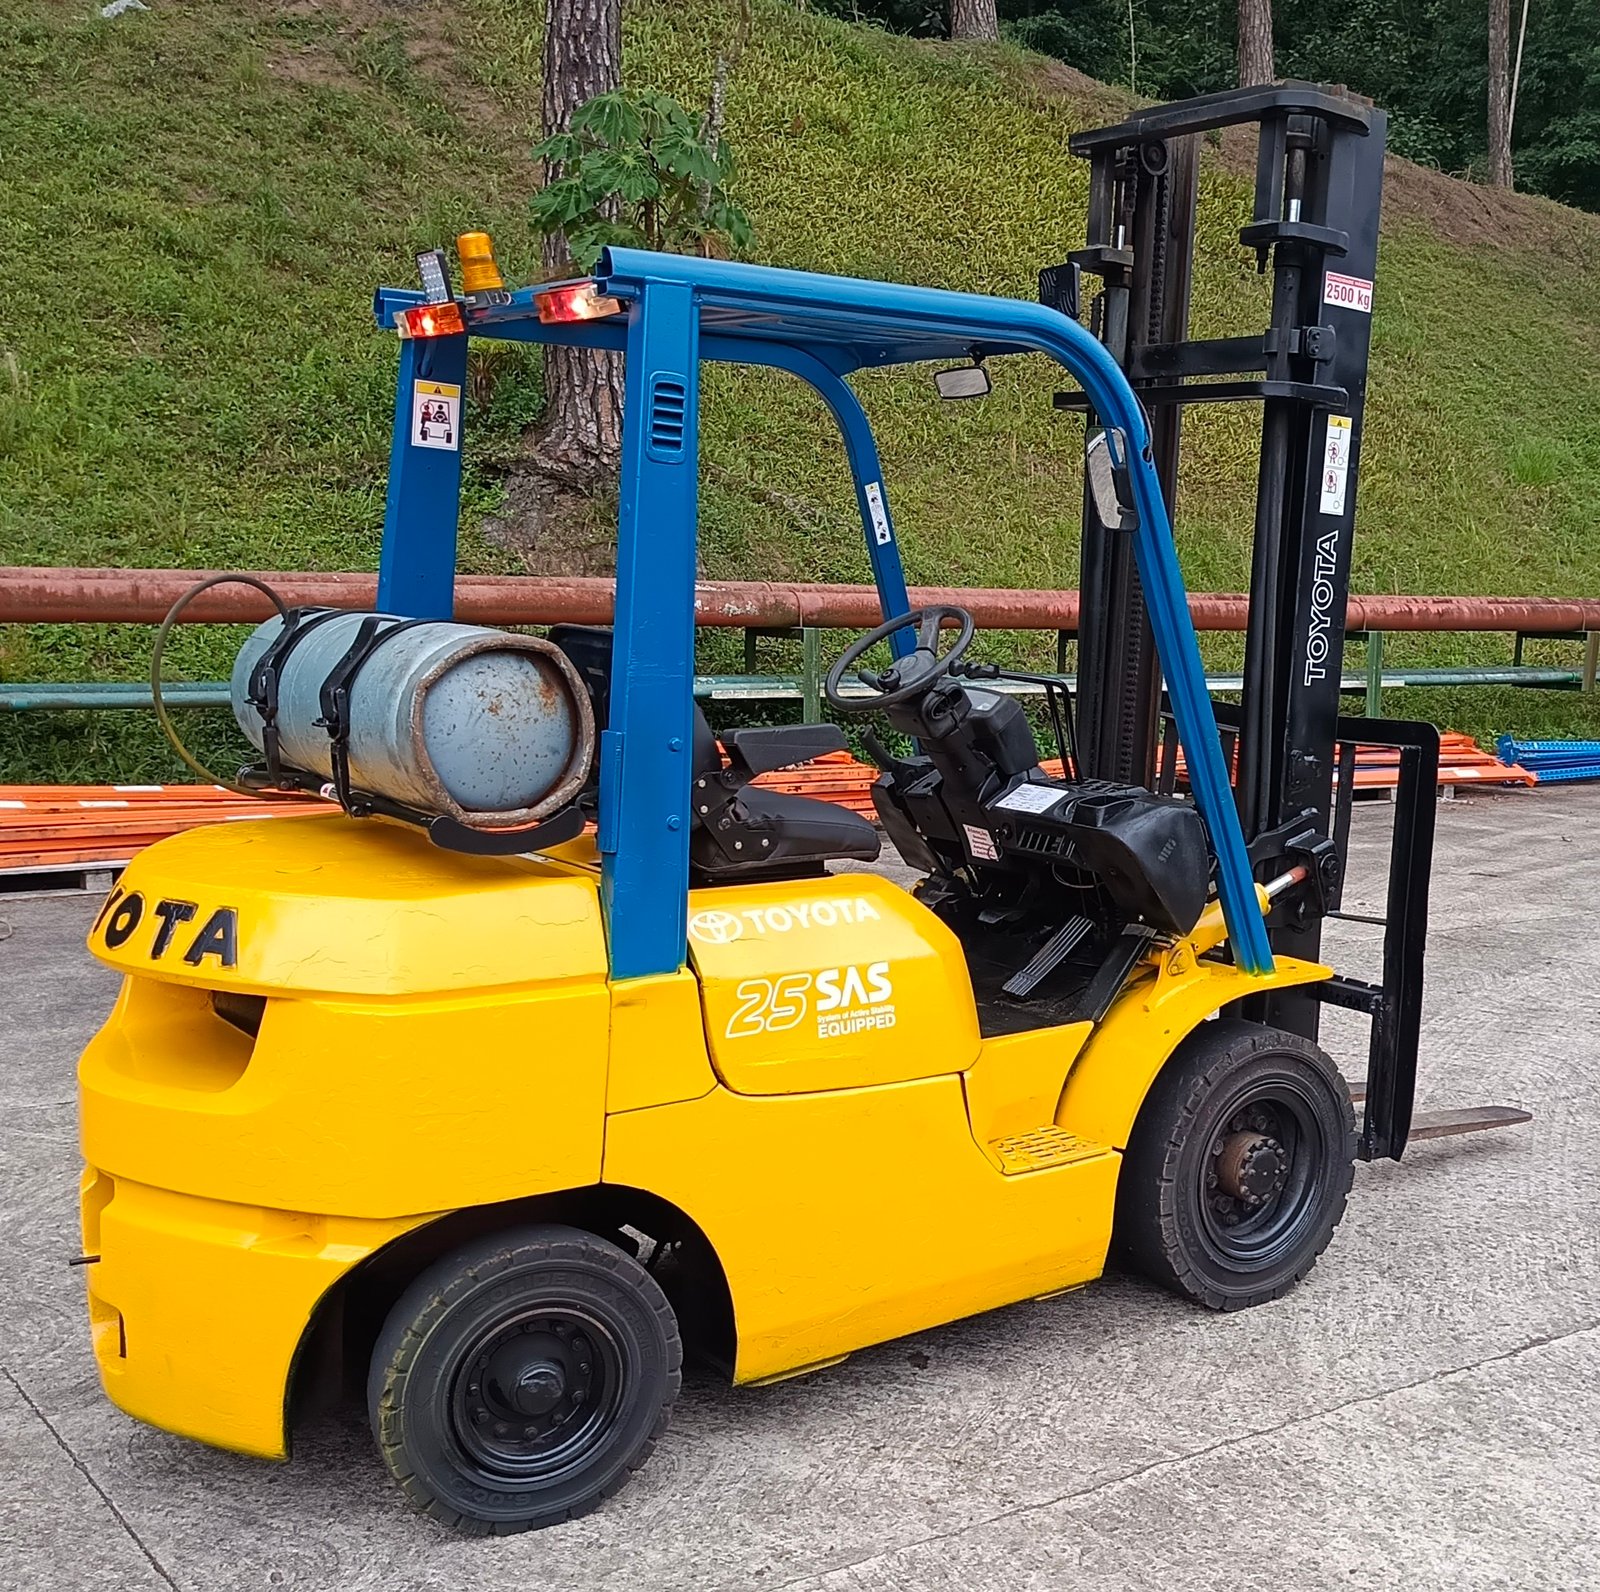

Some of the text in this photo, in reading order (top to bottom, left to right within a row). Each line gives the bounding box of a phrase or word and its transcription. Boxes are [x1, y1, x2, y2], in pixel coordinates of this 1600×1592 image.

[1326, 283, 1370, 310] 2500 kg
[1304, 530, 1339, 686] TOYOTA
[742, 898, 880, 934] TOYOTA
[815, 961, 892, 1011] SAS
[725, 973, 812, 1039] 25
[817, 1014, 841, 1024] System
[818, 1013, 896, 1038] EQUIPPED
